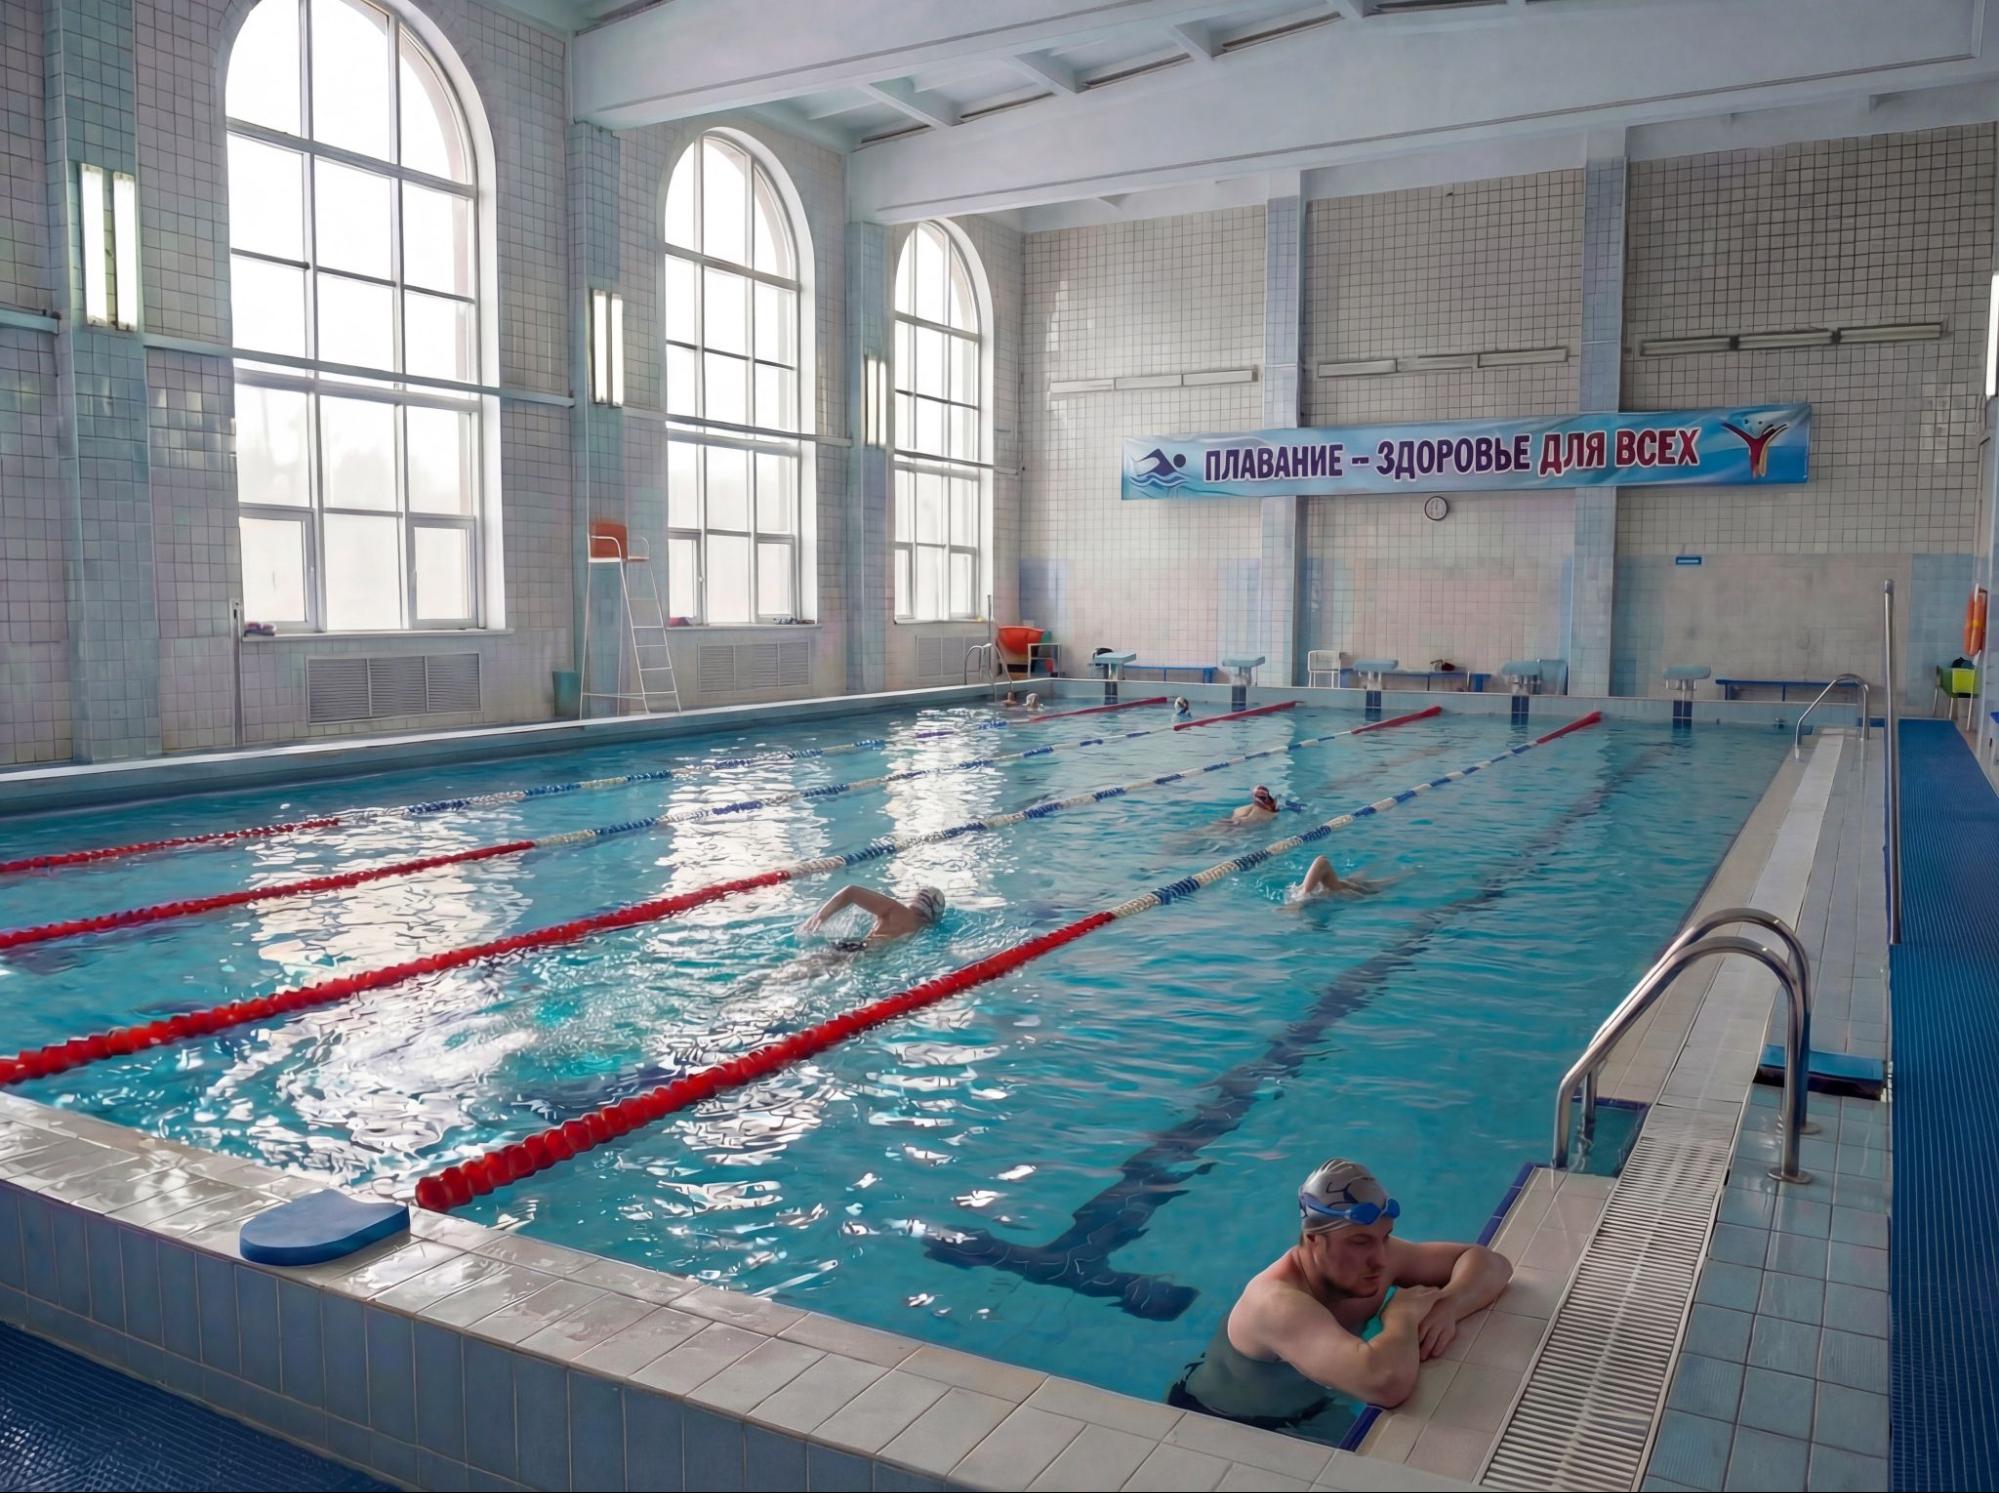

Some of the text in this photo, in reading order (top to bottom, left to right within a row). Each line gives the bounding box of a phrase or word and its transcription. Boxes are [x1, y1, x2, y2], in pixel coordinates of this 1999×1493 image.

[1205, 444, 1343, 481] ПЛАВАНИЕ
[1376, 435, 1530, 479] ЗДОРОВЬЕ
[1540, 432, 1605, 475] ДЛЯ
[1616, 428, 1699, 466] ВСЕХ
